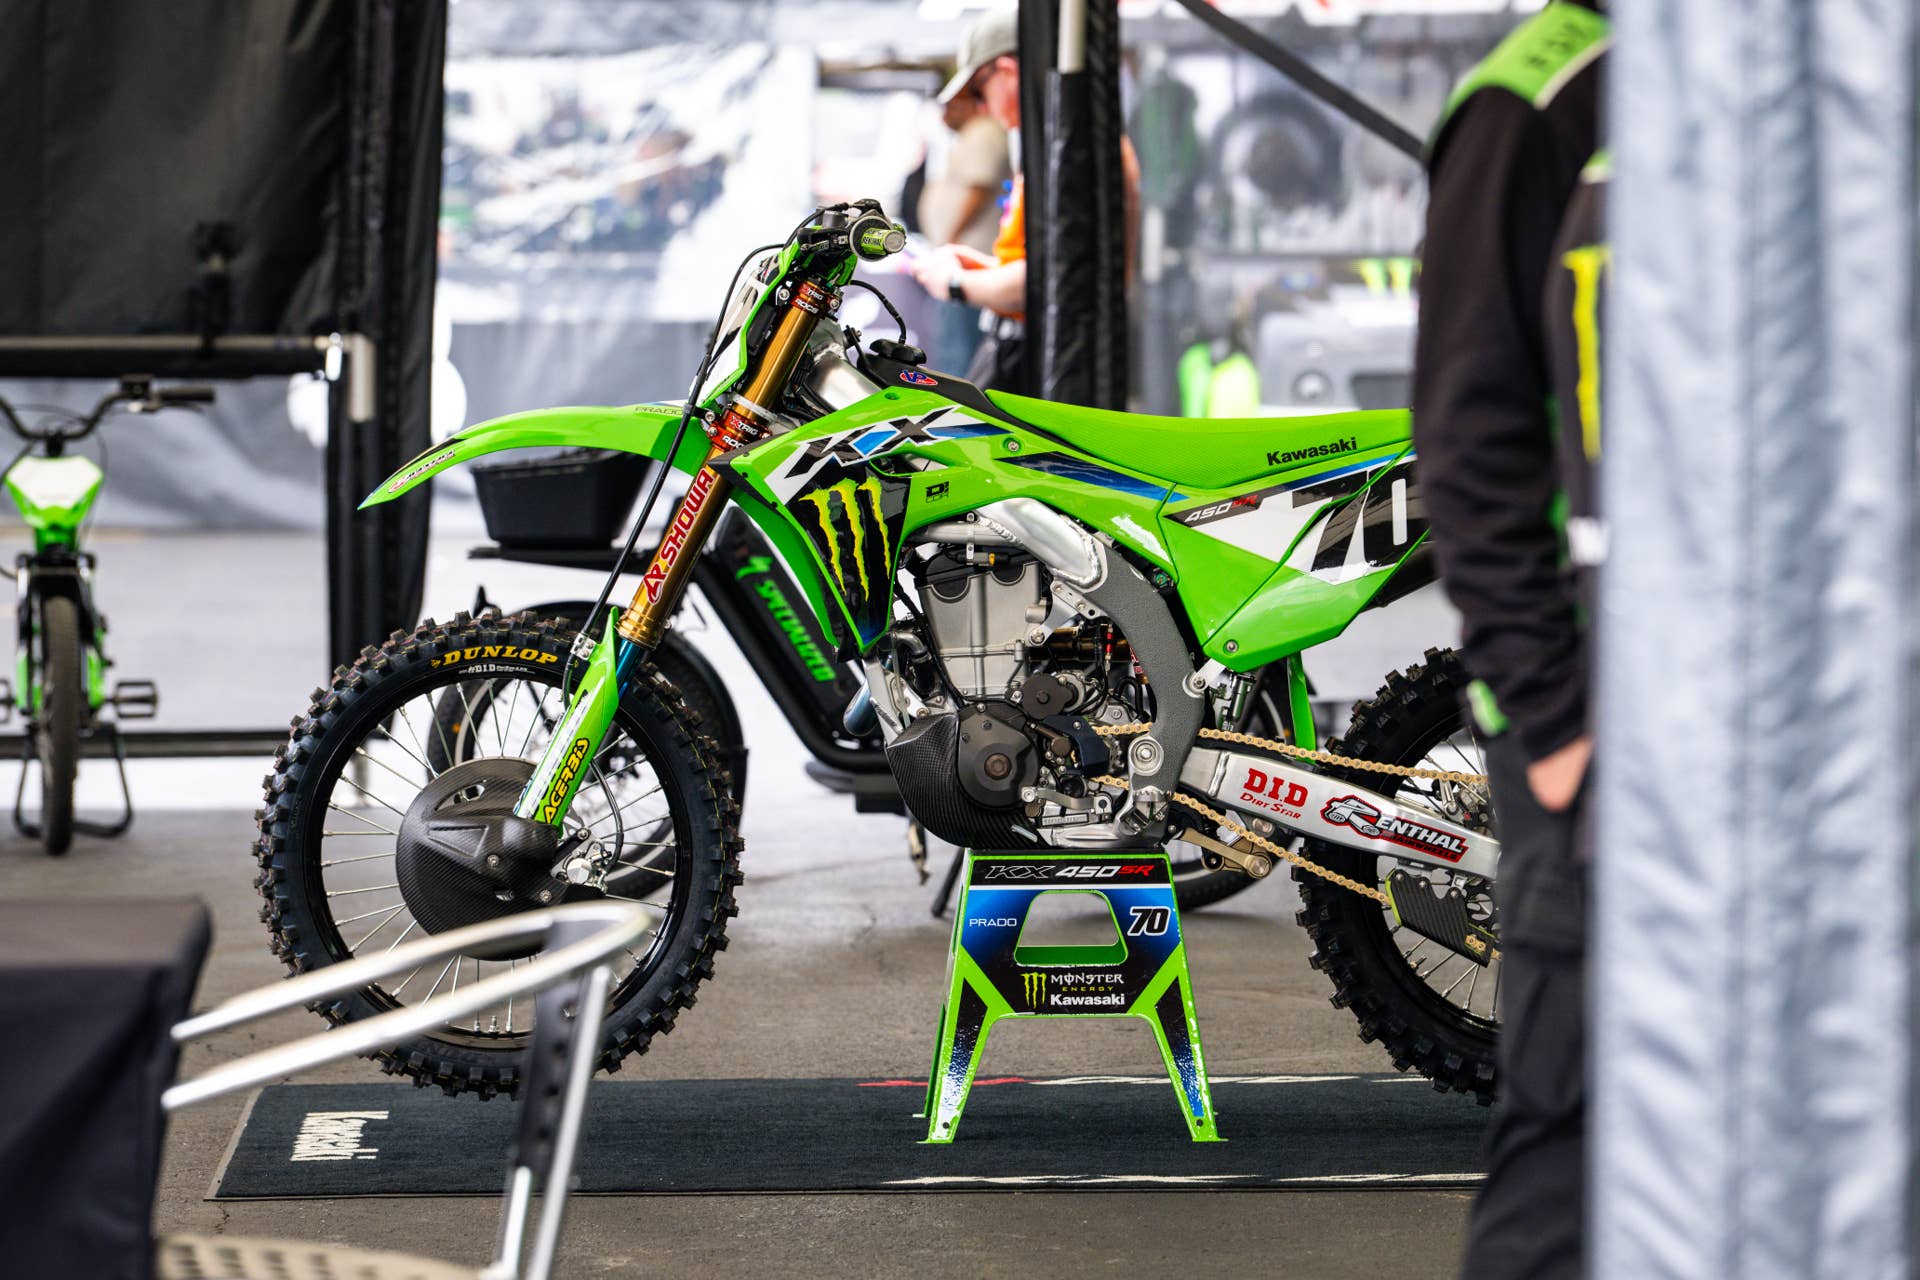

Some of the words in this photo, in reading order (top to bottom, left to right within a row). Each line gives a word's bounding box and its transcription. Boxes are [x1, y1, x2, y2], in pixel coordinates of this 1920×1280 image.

[1266, 437, 1358, 467] Kawasaki
[660, 468, 715, 568] SHOWA
[443, 645, 559, 666] DUNLOP
[1243, 767, 1309, 808] D.I.D
[984, 865, 1056, 879] KX
[969, 918, 1018, 927] PRADO
[1127, 906, 1171, 937] 70
[1050, 973, 1125, 986] MONSTER
[1050, 993, 1126, 1006] Kawasaki
